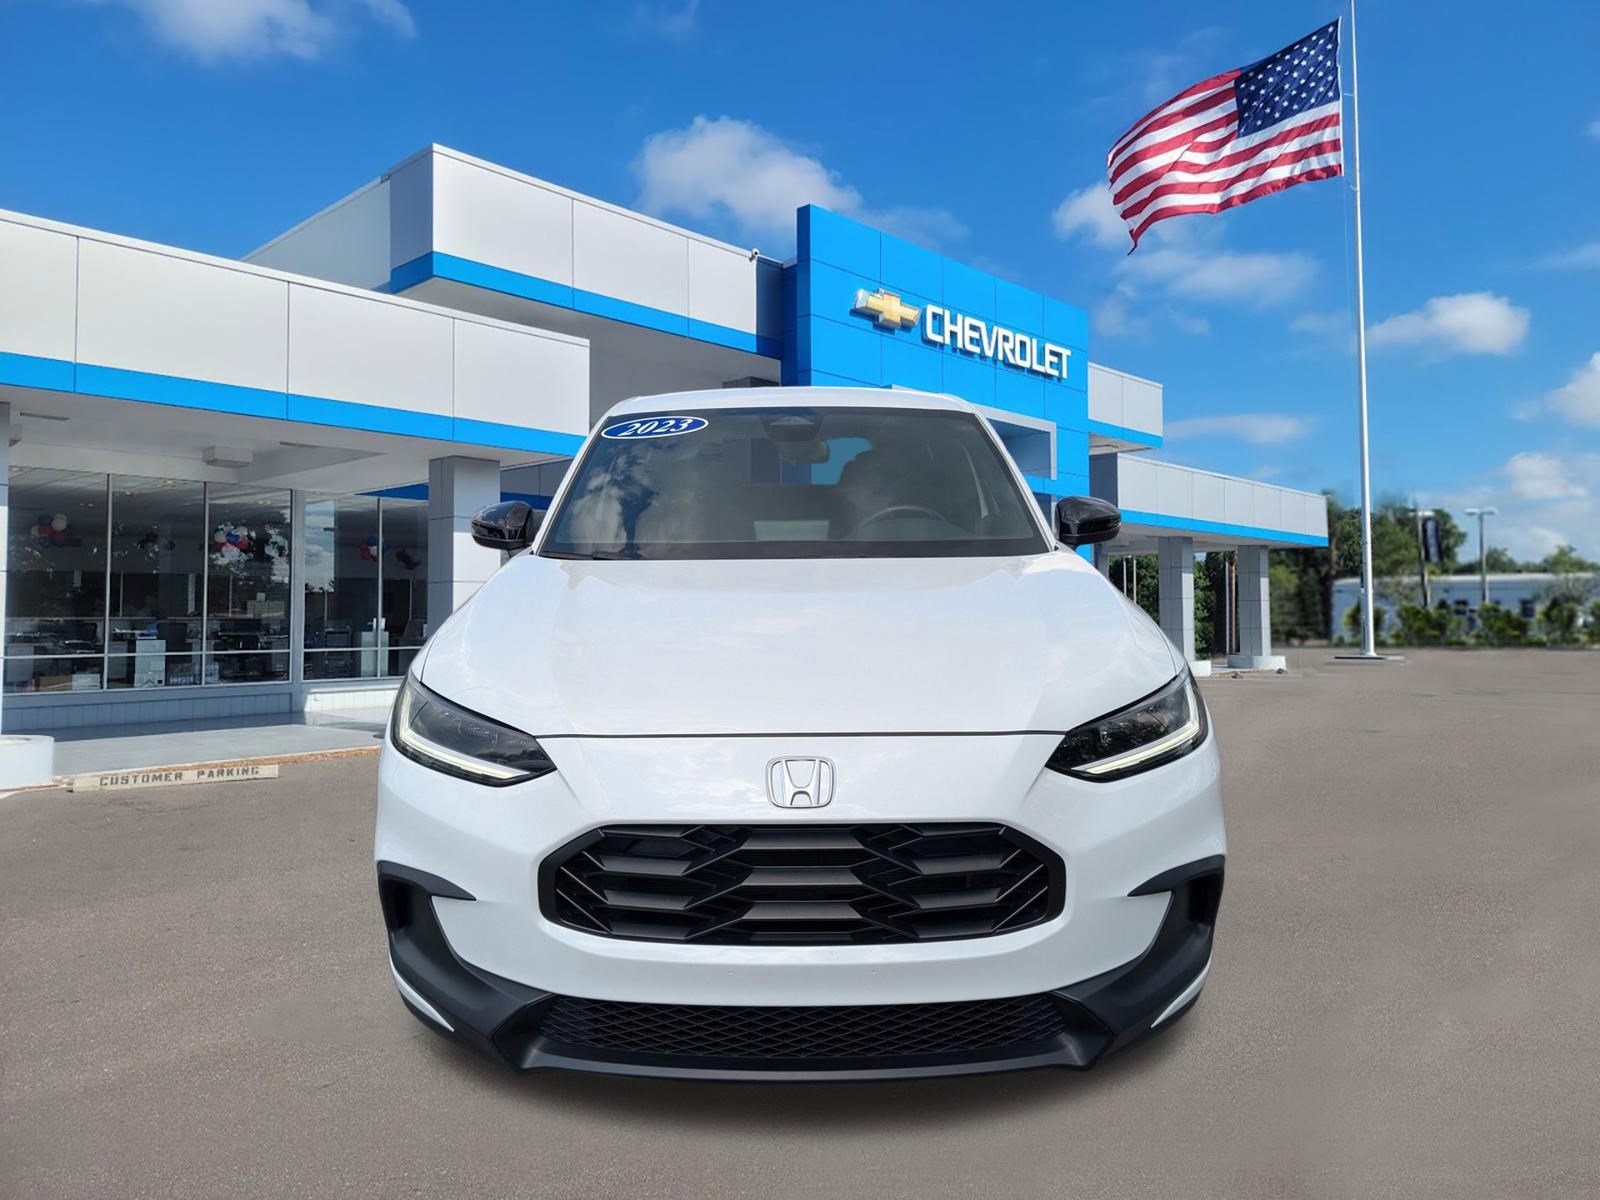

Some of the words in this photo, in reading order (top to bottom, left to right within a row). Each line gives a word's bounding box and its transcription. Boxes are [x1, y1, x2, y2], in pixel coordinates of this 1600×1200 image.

[924, 304, 1071, 379] CHEVROLET
[617, 419, 694, 437] 2023
[100, 772, 183, 786] CUSTOMER
[197, 766, 259, 779] PARKING
